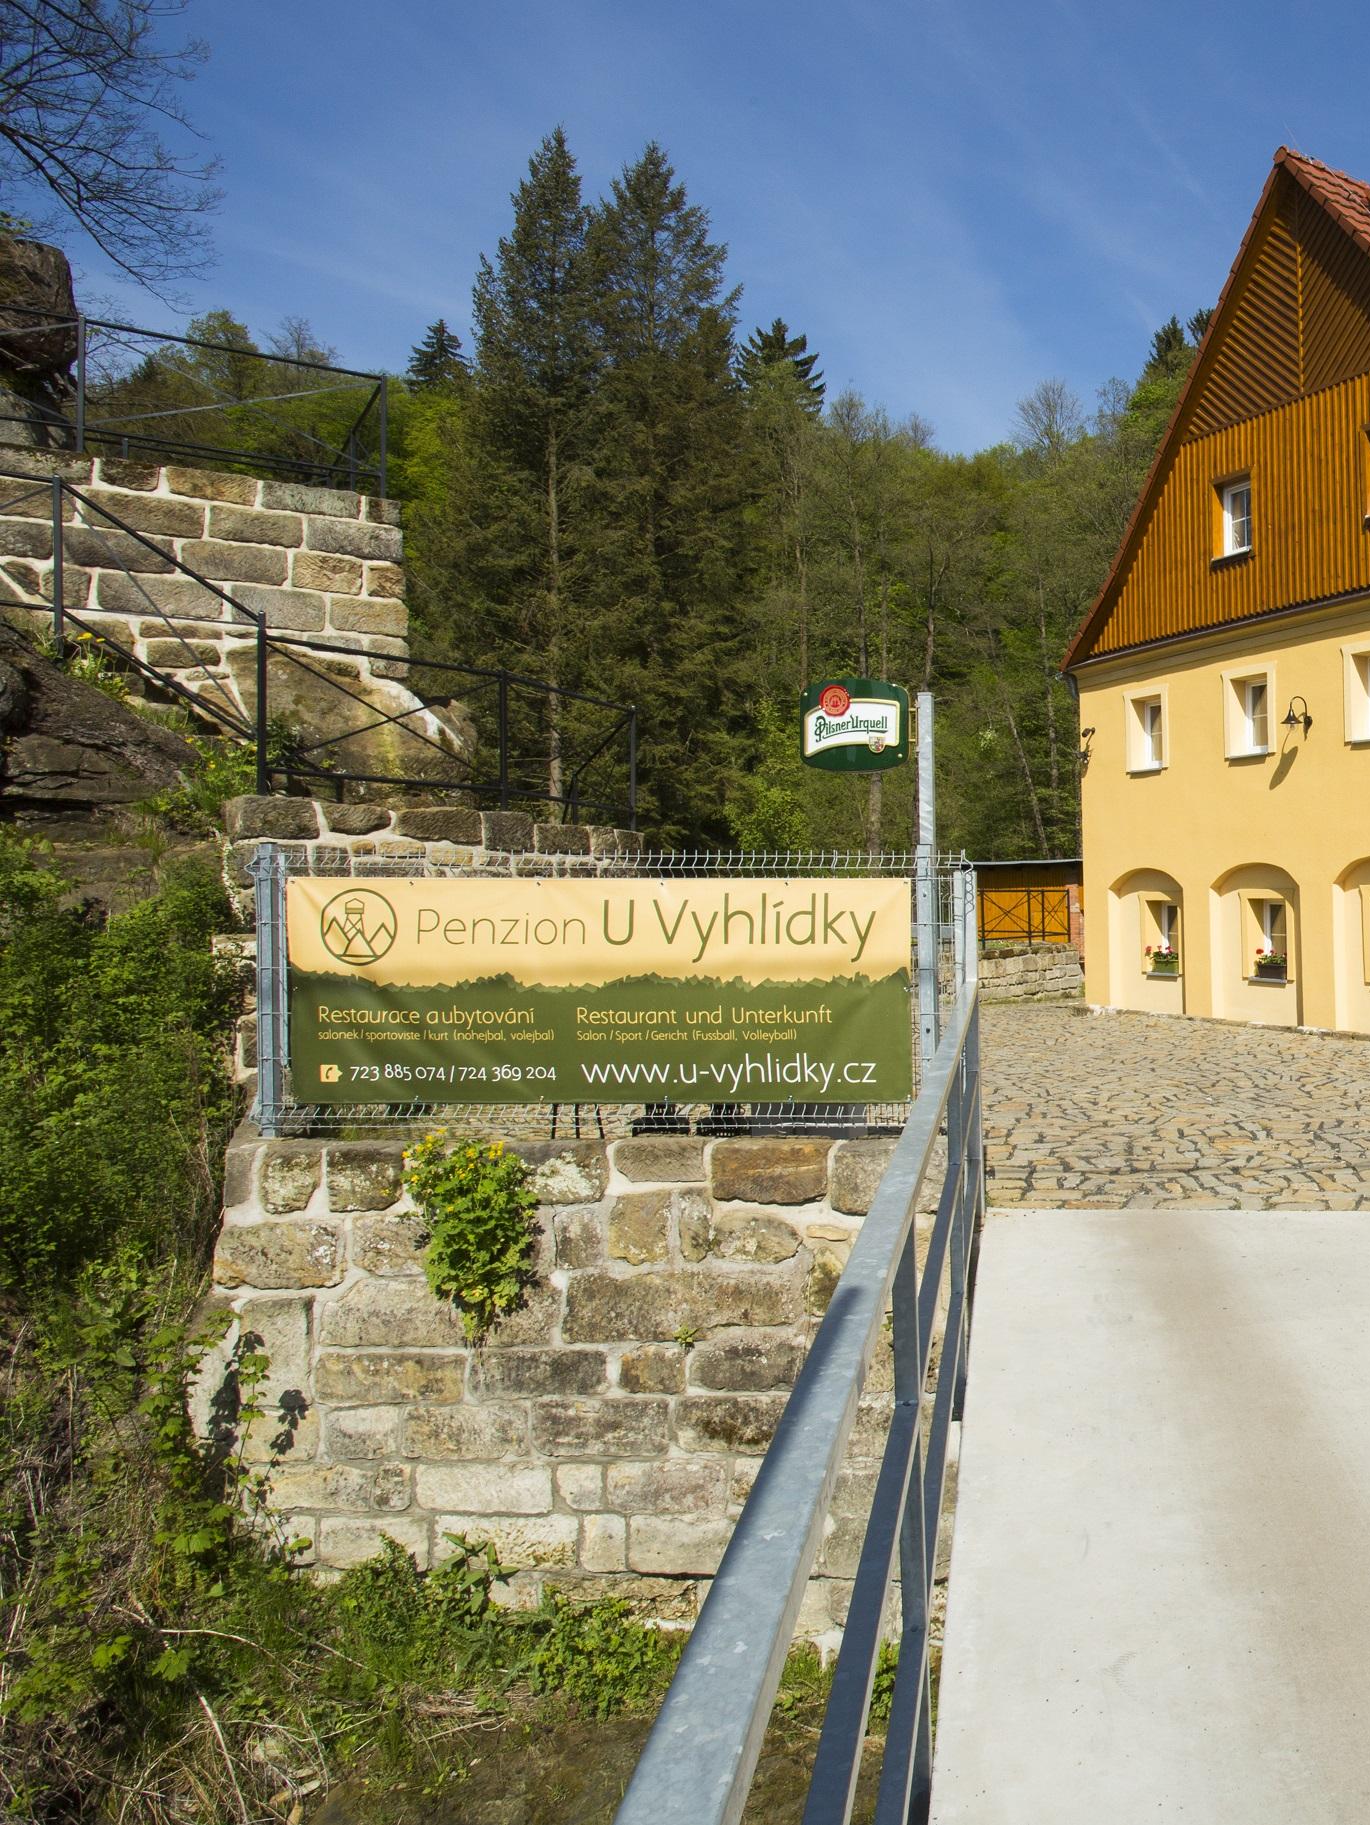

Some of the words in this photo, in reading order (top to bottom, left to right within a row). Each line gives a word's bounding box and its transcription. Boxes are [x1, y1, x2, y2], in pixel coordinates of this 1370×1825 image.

[815, 716, 851, 742] Pilsner
[850, 715, 888, 734] Urquell
[416, 908, 587, 946] Penzion
[603, 899, 635, 946] U
[652, 892, 877, 963] Vyhlídky
[318, 1006, 421, 1024] Restaurace
[577, 1007, 677, 1024] Restaurant
[686, 1006, 723, 1024] und
[732, 1005, 833, 1024] Unterkunft
[350, 1065, 380, 1081] 723
[384, 1063, 412, 1080] 885
[415, 1066, 446, 1080] 074
[459, 1066, 488, 1081] 724
[492, 1064, 522, 1081] 369
[526, 1066, 558, 1081] 204
[581, 1053, 877, 1093] www.u-vyhlidky.cz
